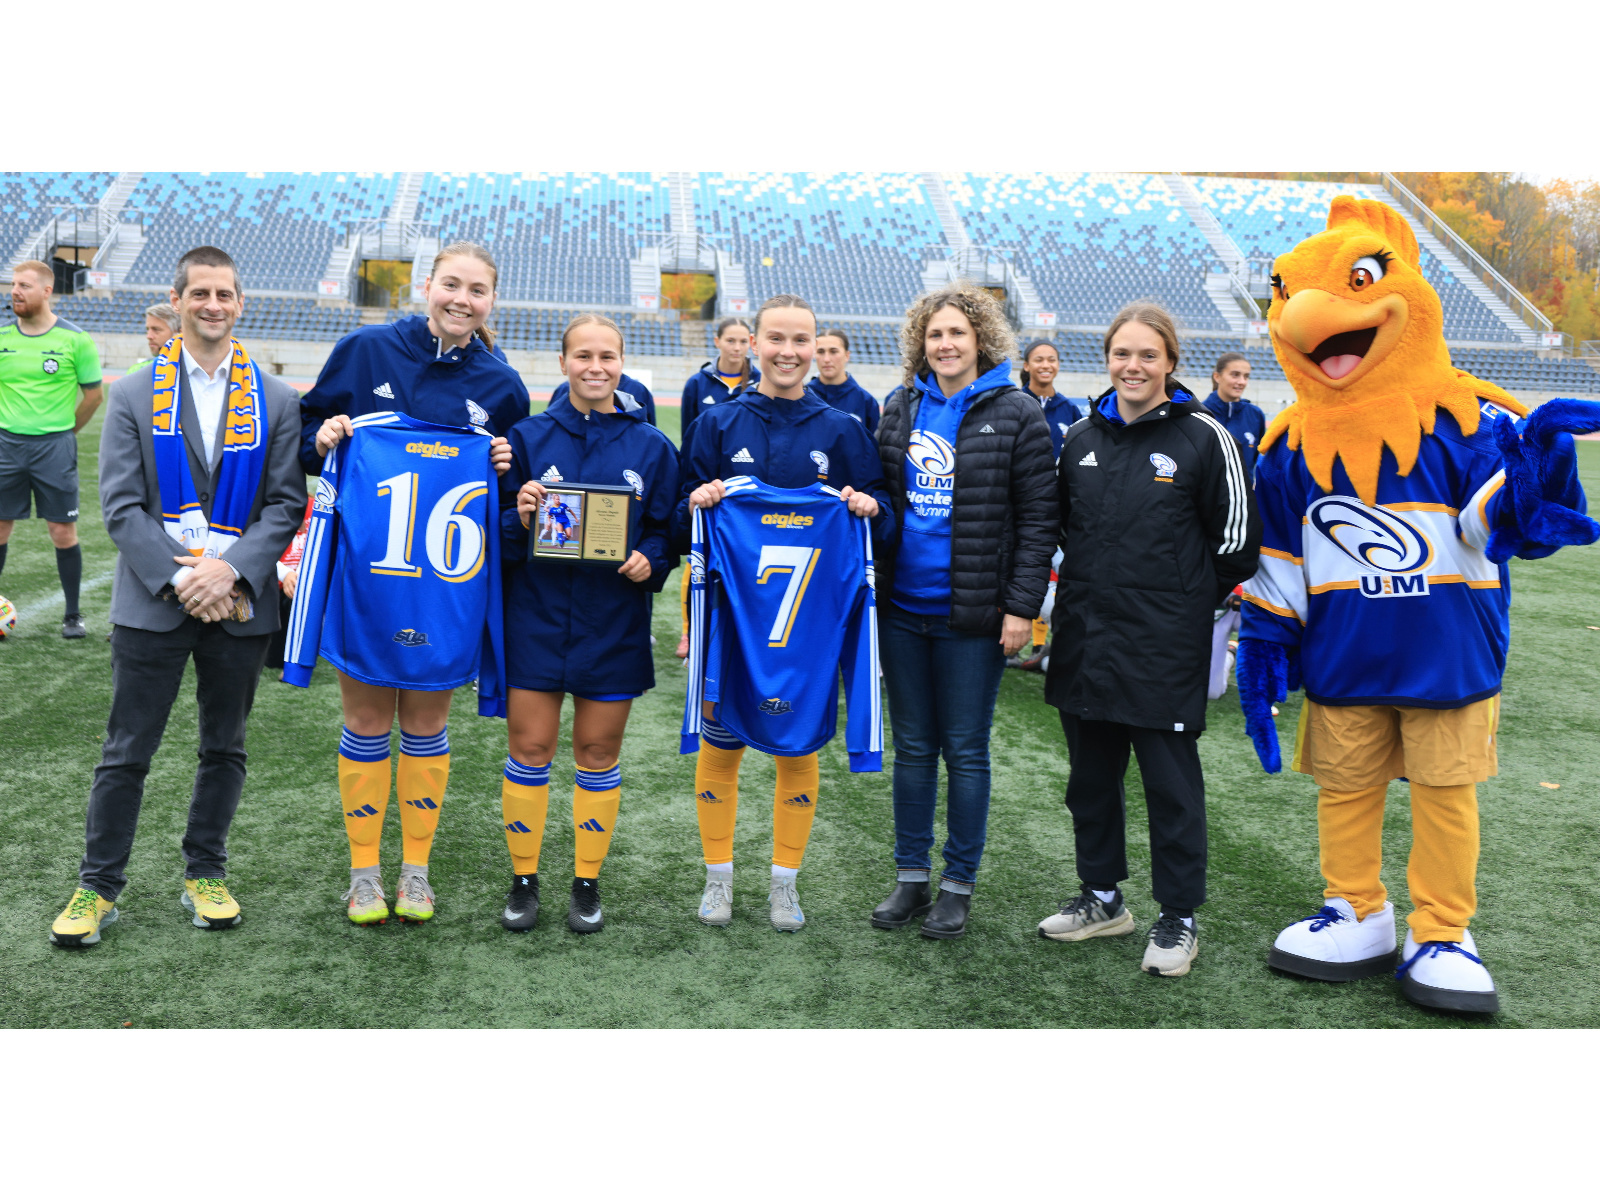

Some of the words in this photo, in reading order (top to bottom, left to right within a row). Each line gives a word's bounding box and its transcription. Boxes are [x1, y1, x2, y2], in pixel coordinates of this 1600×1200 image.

[370, 471, 488, 583] 16
[906, 490, 953, 505] Hocke
[756, 545, 822, 648] 7
